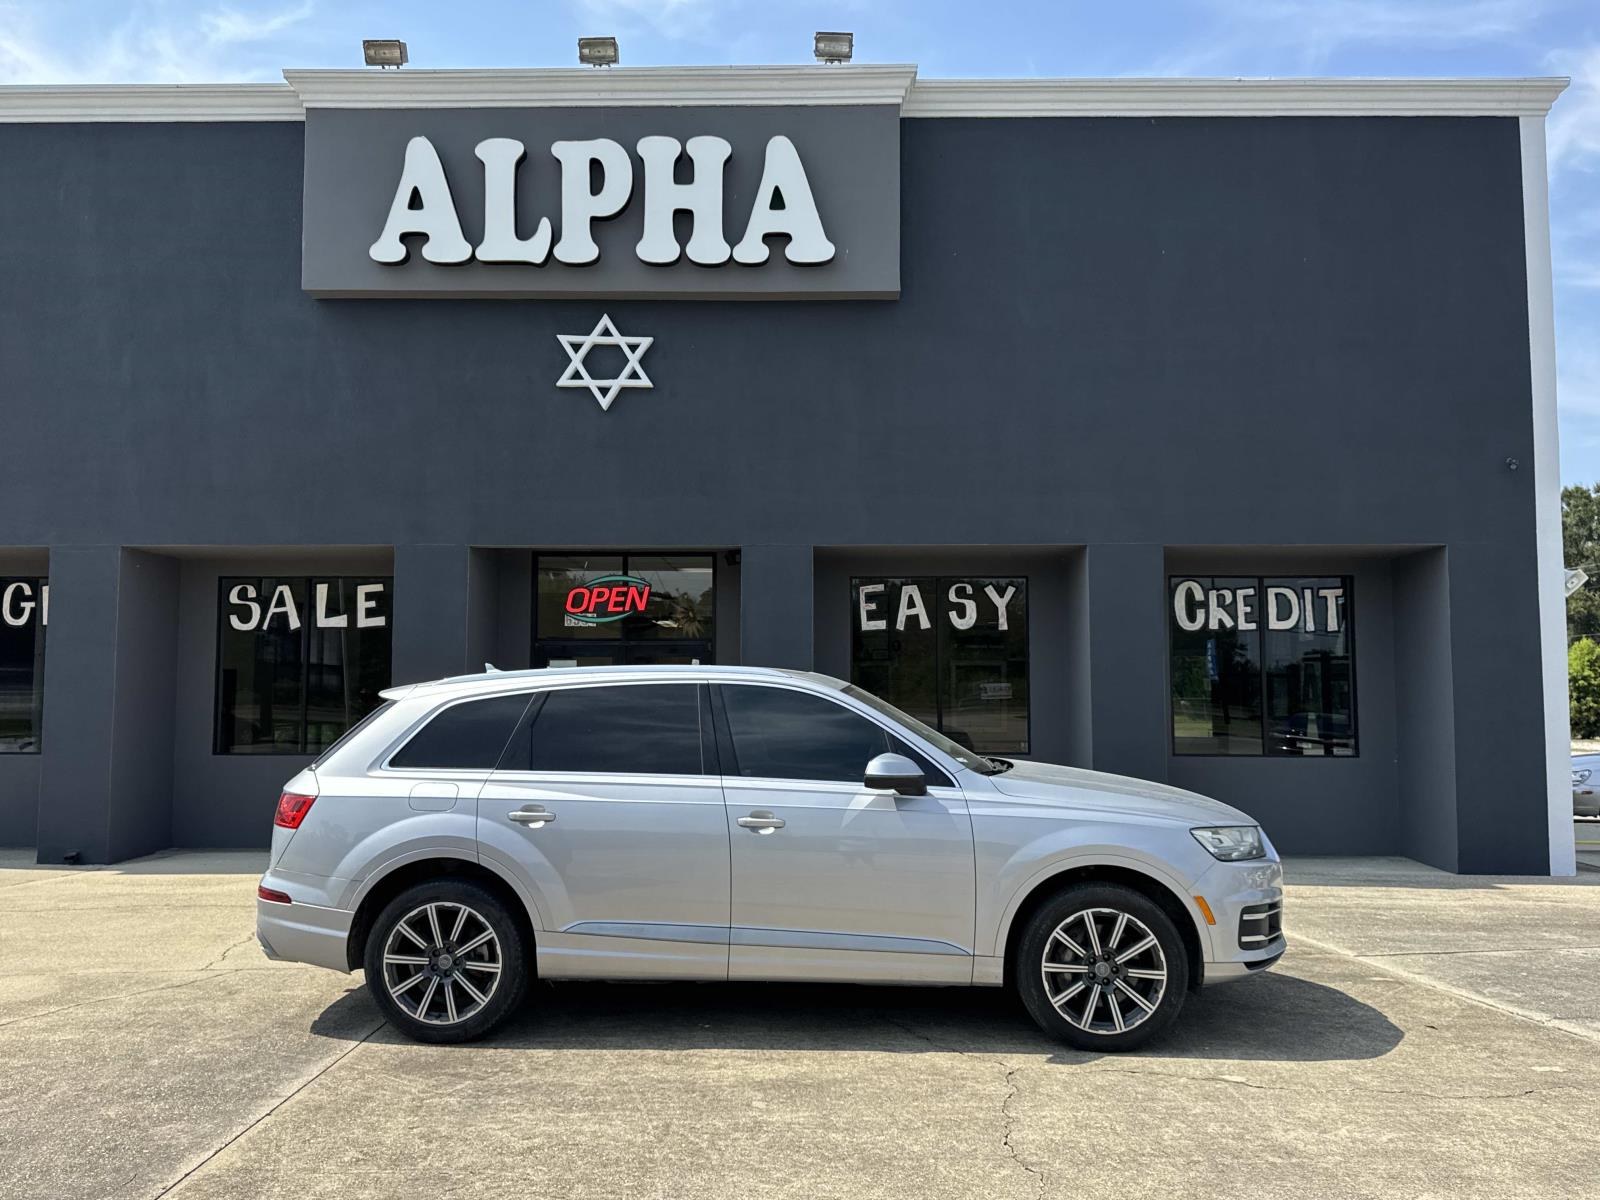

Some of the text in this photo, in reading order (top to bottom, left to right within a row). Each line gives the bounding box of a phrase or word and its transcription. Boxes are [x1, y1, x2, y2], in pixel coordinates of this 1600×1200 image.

[369, 136, 836, 264] ALPHA
[229, 583, 386, 631] SALE
[565, 586, 650, 613] OPEN
[859, 583, 1016, 631] EASY
